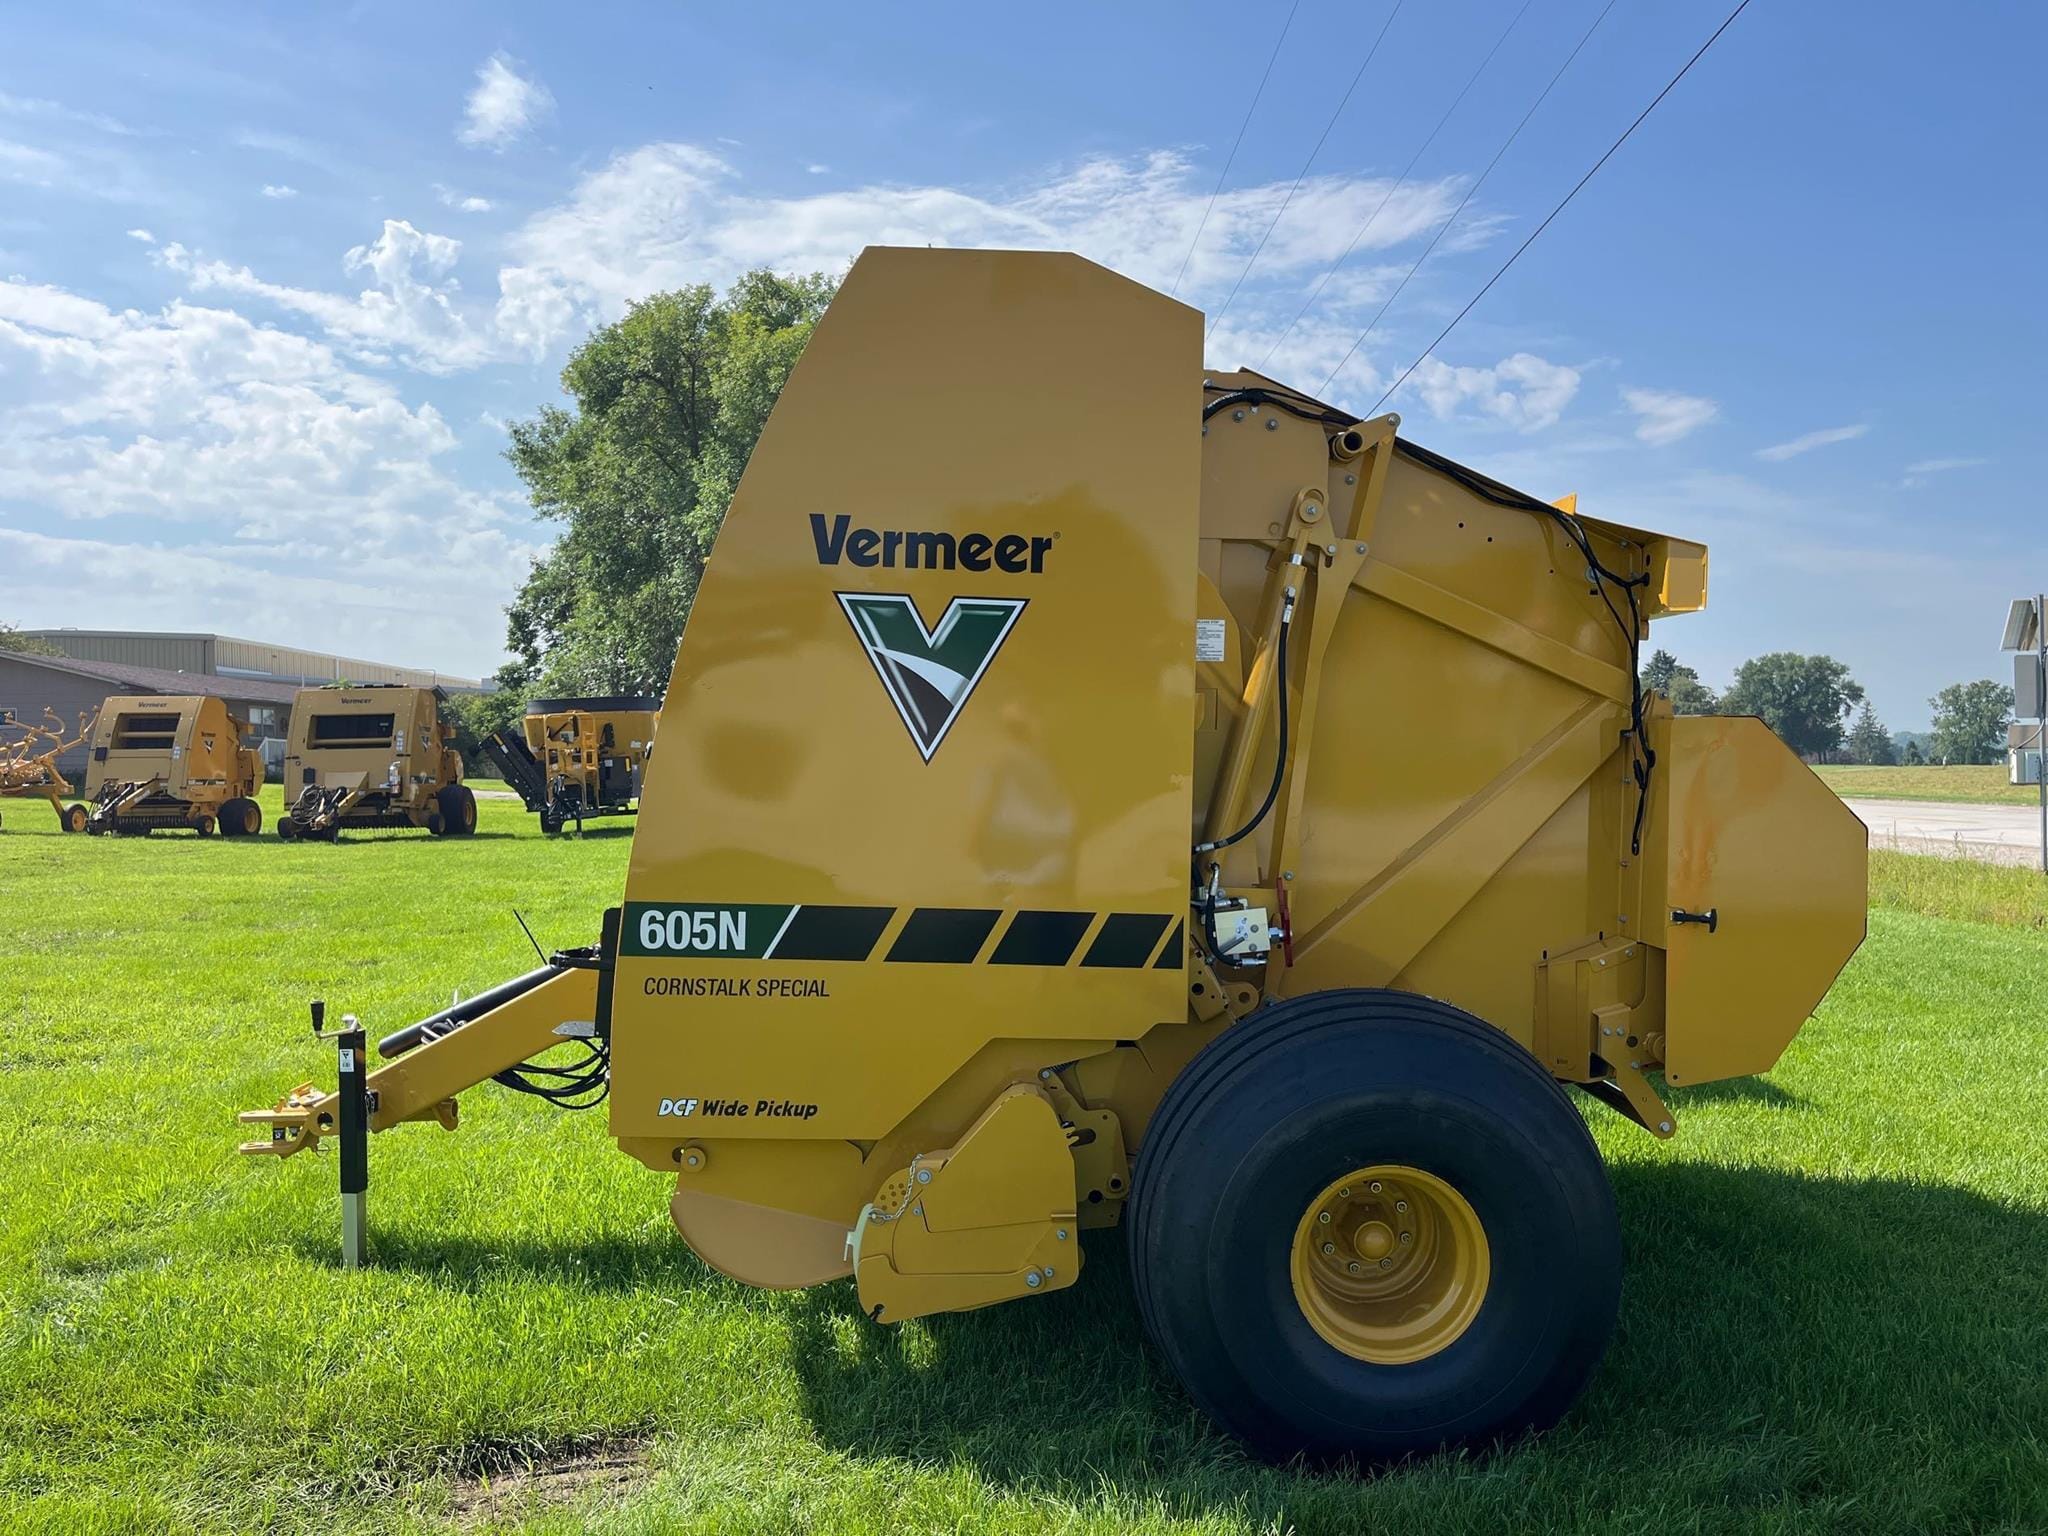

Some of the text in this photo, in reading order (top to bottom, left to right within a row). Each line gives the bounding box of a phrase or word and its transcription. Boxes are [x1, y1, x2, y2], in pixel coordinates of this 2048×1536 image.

[809, 512, 1053, 574] Vermeer
[639, 909, 747, 951] 605N
[643, 977, 830, 997] CORNSTALK SPECIAL
[657, 1098, 818, 1120] DCF Wide Pickup
